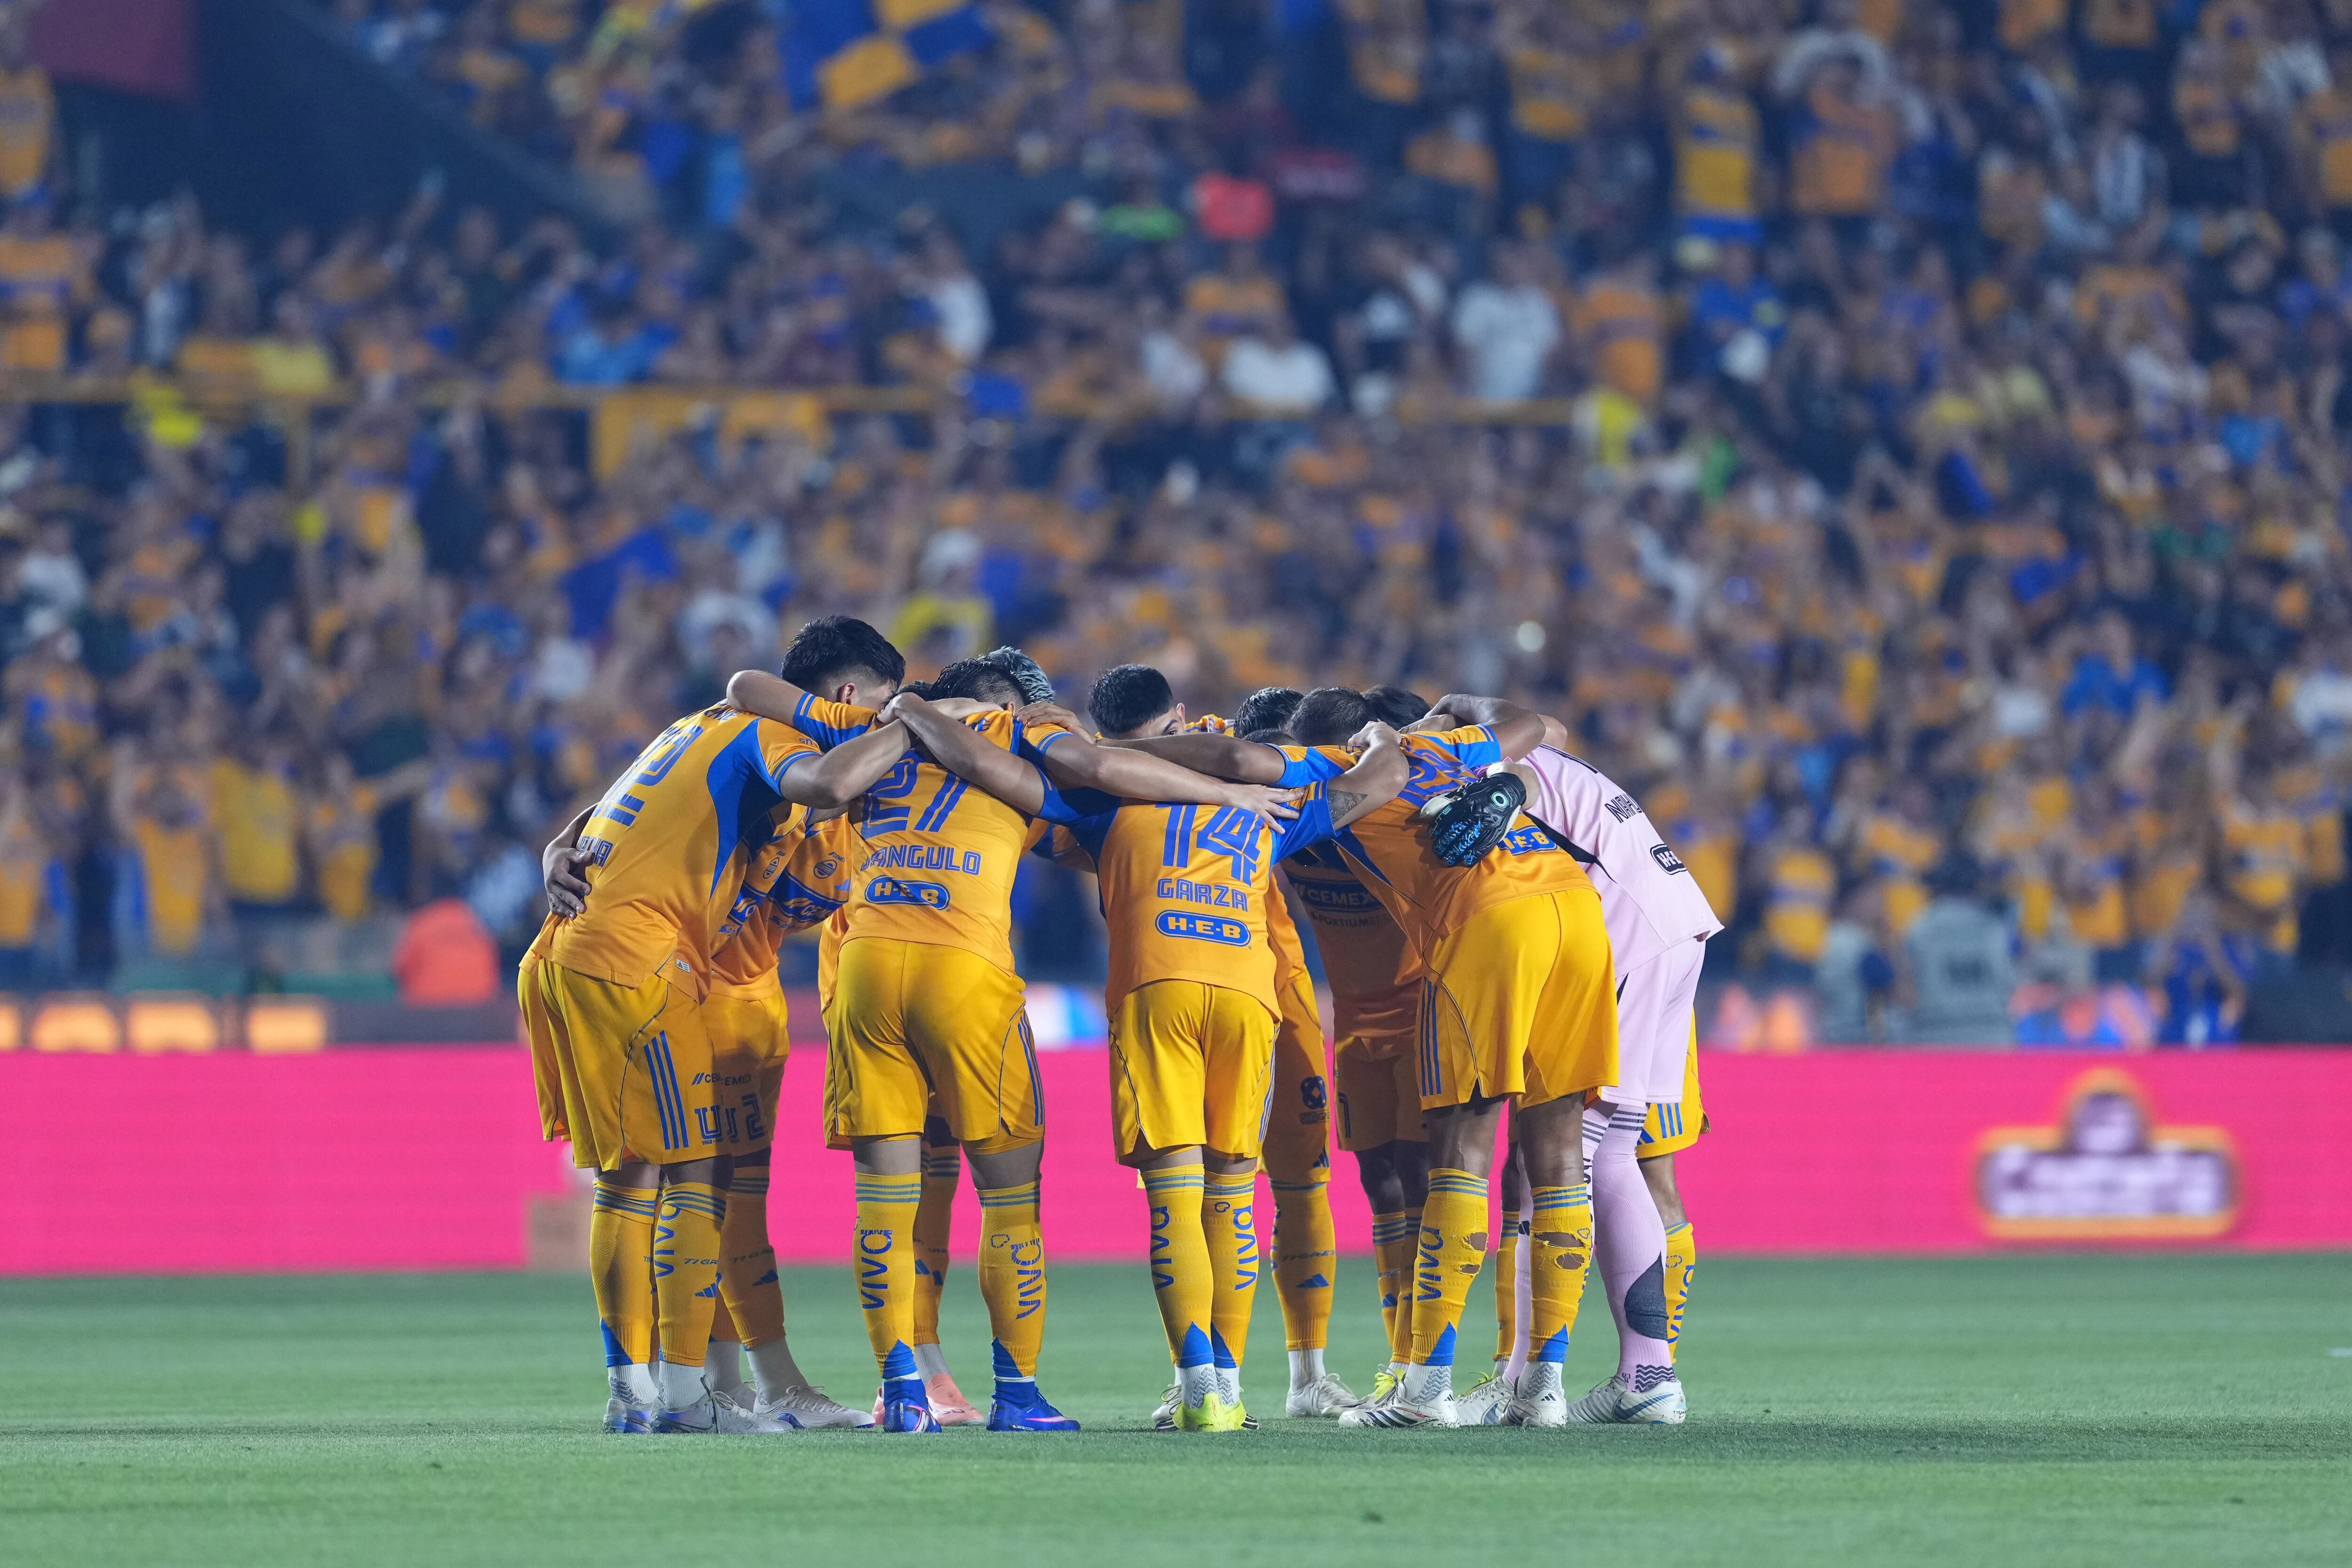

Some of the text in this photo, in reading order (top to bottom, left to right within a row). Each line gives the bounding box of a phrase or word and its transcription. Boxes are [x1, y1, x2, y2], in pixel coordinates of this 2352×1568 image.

[1155, 802, 1265, 888] 14
[1157, 878, 1248, 912] GARZA
[1167, 916, 1241, 938] H-E-B
